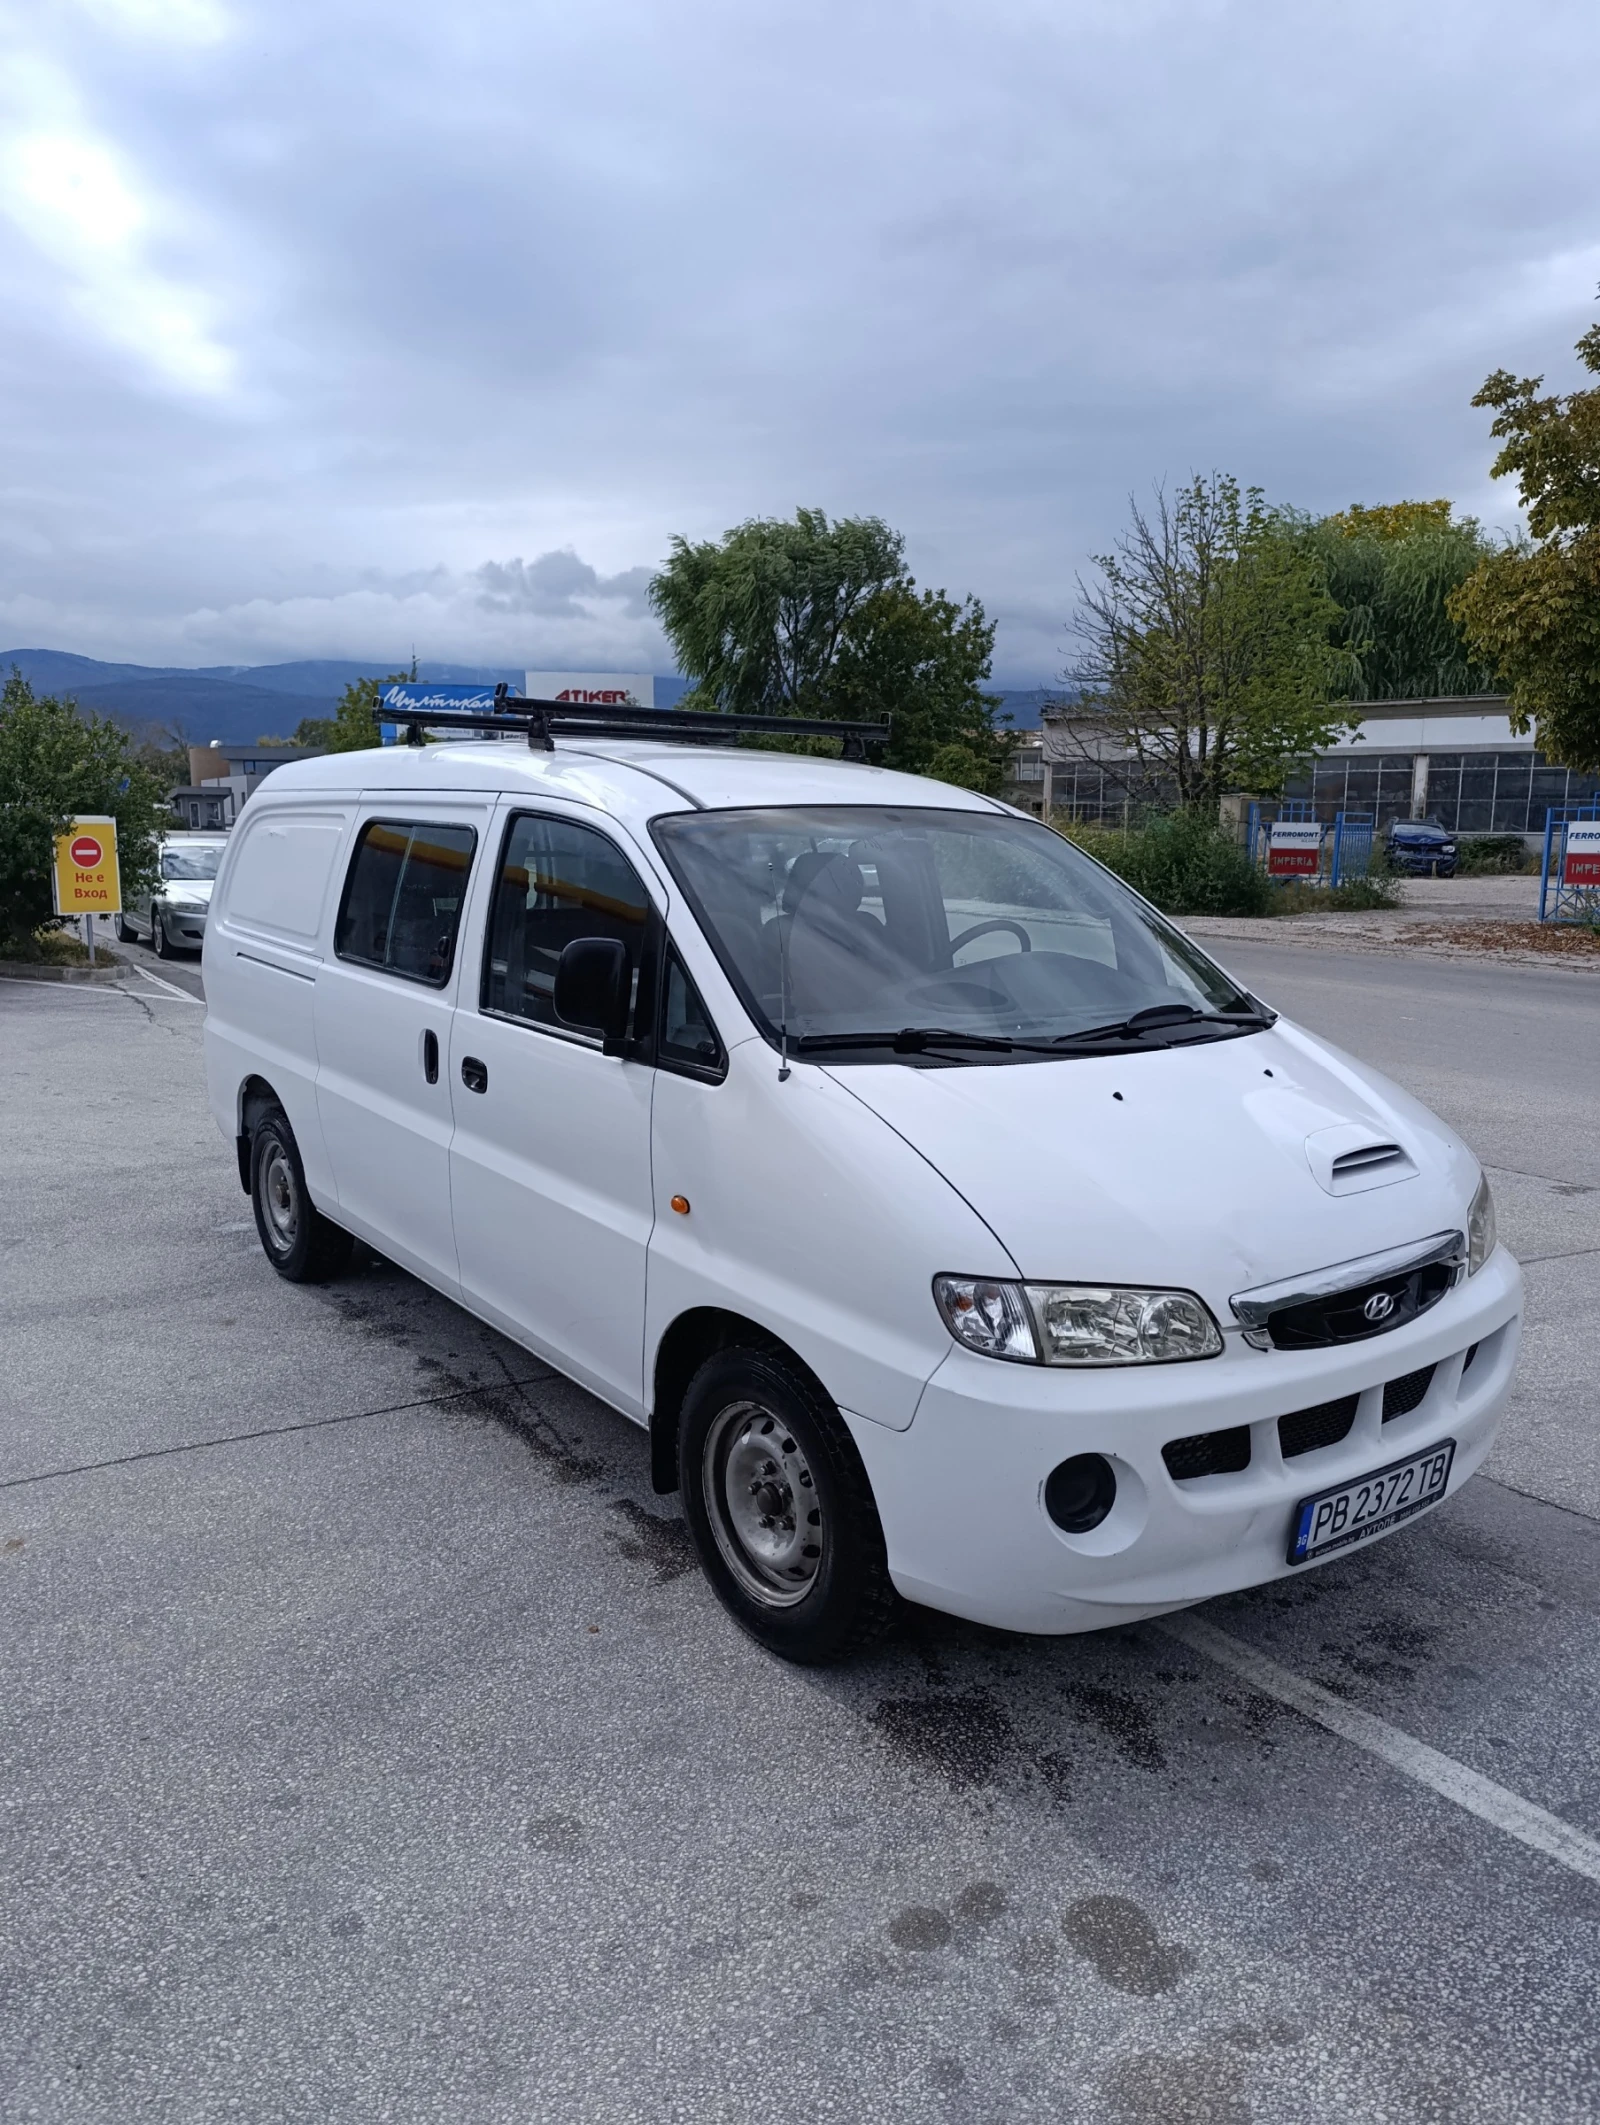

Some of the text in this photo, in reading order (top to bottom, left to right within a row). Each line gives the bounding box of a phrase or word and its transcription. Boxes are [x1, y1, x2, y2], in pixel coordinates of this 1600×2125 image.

[555, 689, 627, 704] ATIKER
[1274, 857, 1313, 866] IMPERIA
[75, 872, 104, 883] Не е
[74, 888, 107, 899] Вход
[1313, 1495, 1350, 1541] PB
[1352, 1468, 1414, 1524] 2372
[1419, 1453, 1446, 1494] TB
